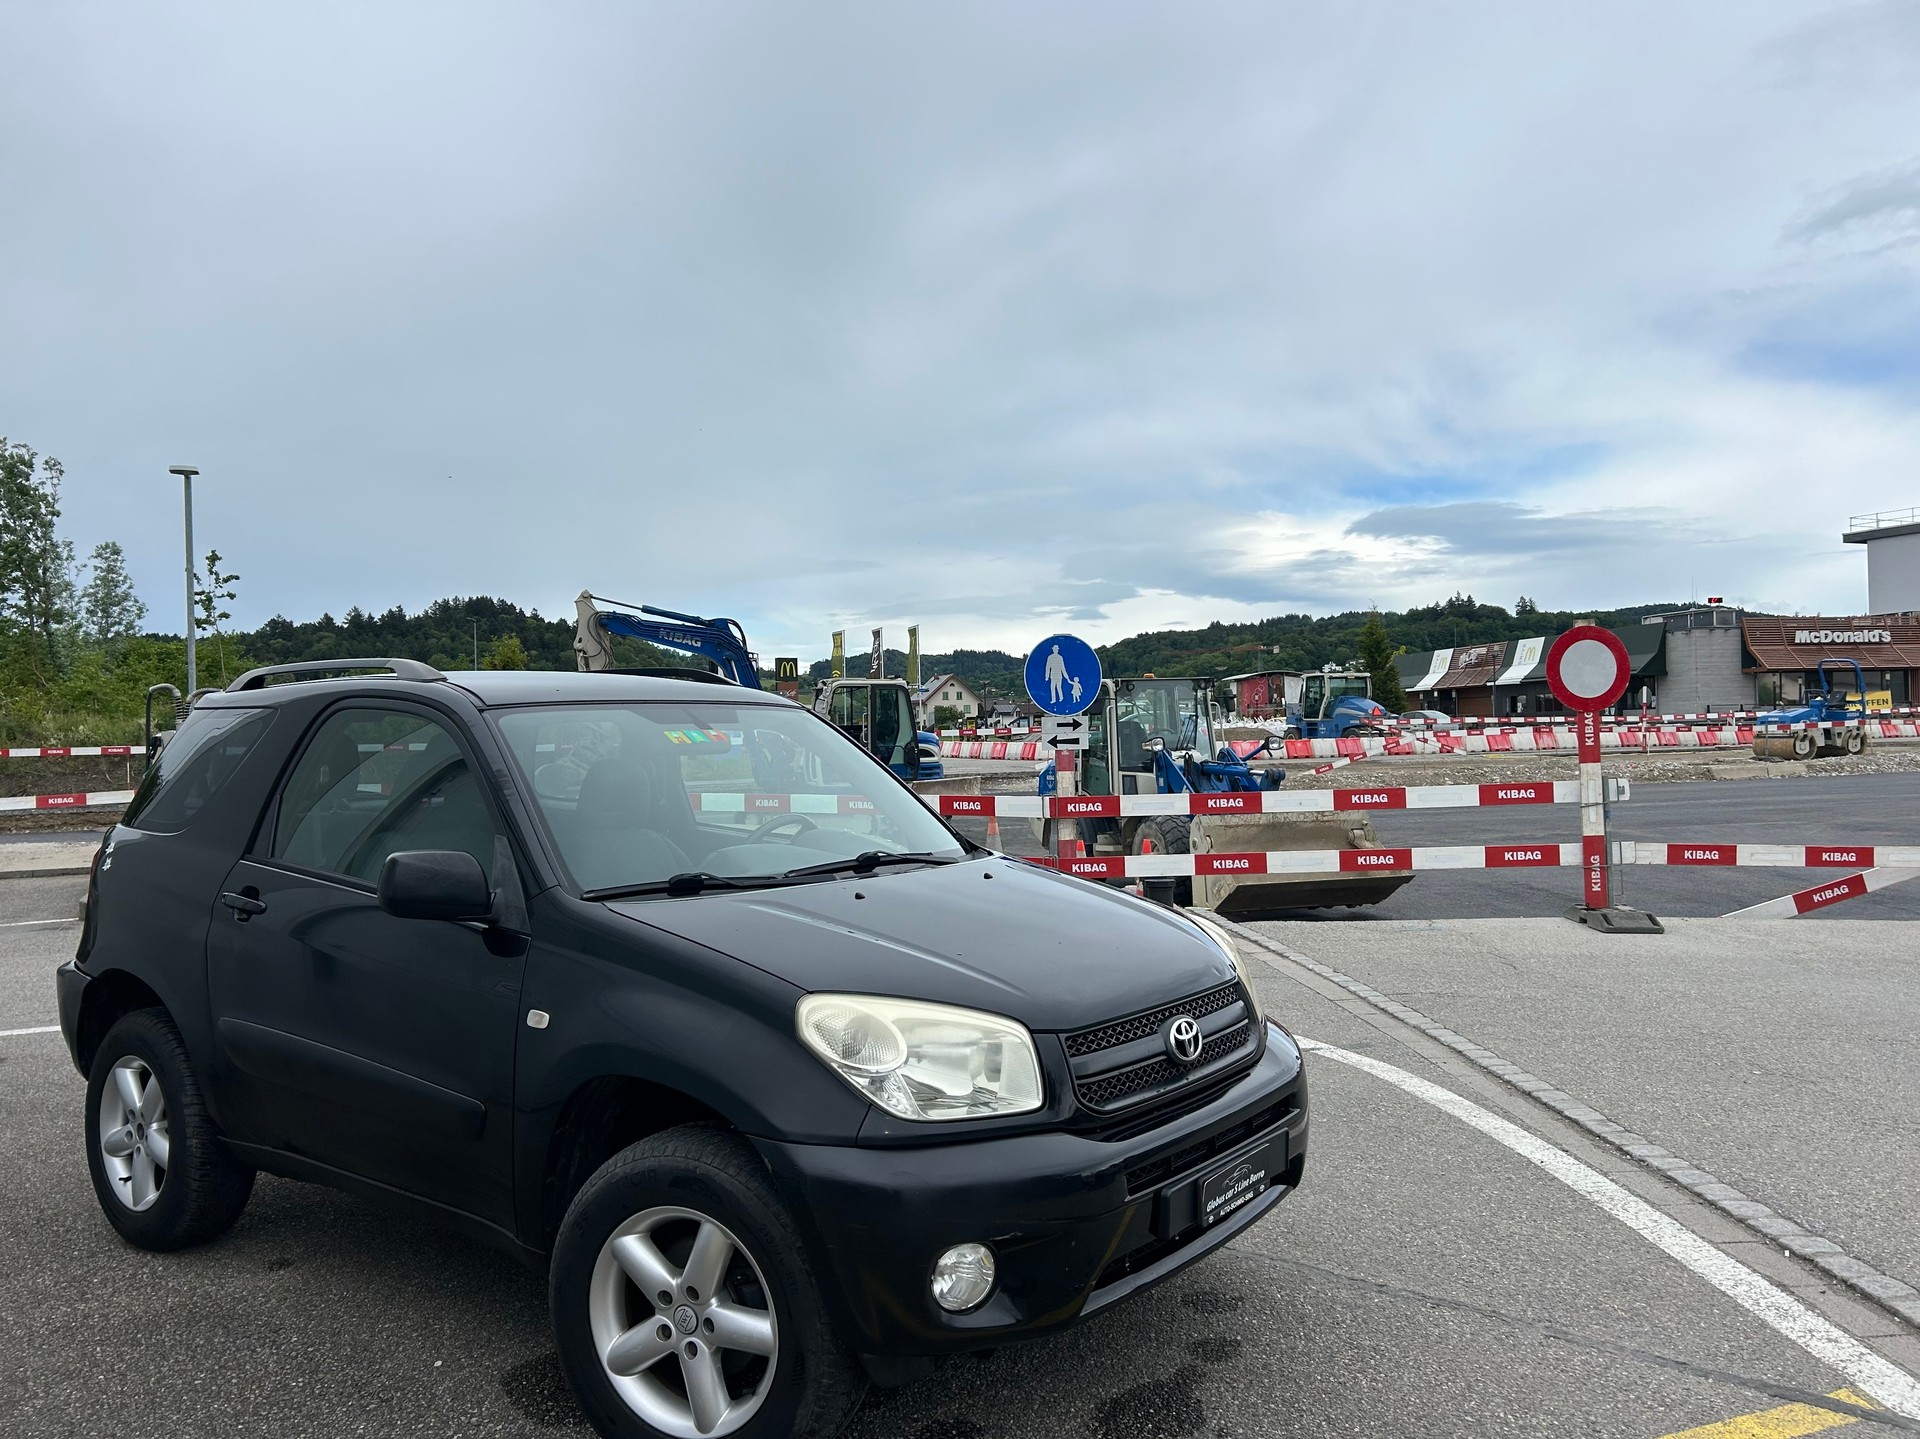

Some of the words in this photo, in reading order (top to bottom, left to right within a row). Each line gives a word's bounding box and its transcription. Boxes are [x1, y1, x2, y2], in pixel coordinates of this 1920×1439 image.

[659, 628, 702, 647] KIBAG
[1795, 629, 1892, 644] McDonald's
[1866, 698, 1889, 706] FFEN
[1584, 711, 1594, 746] KIBAG
[1351, 793, 1388, 804] KIBAG
[1497, 789, 1536, 799] KIBAG
[755, 799, 779, 807] KIBAG
[849, 801, 874, 809] KIBAG
[953, 801, 981, 810] KIBAG
[1067, 803, 1103, 812] KIBAG
[1207, 798, 1244, 808] KIBAG
[1504, 851, 1542, 861] KIBAG
[1684, 850, 1719, 859] KIBAG
[1822, 852, 1857, 861] KIBAG
[1213, 859, 1249, 869] KIBAG
[1357, 855, 1394, 865] KIBAG
[1072, 863, 1107, 873] KIBAG
[1590, 855, 1601, 891] KIBAG
[1812, 885, 1850, 903] KIBAG
[1207, 1193, 1225, 1212] Globus
[1238, 1178, 1250, 1192] Line
